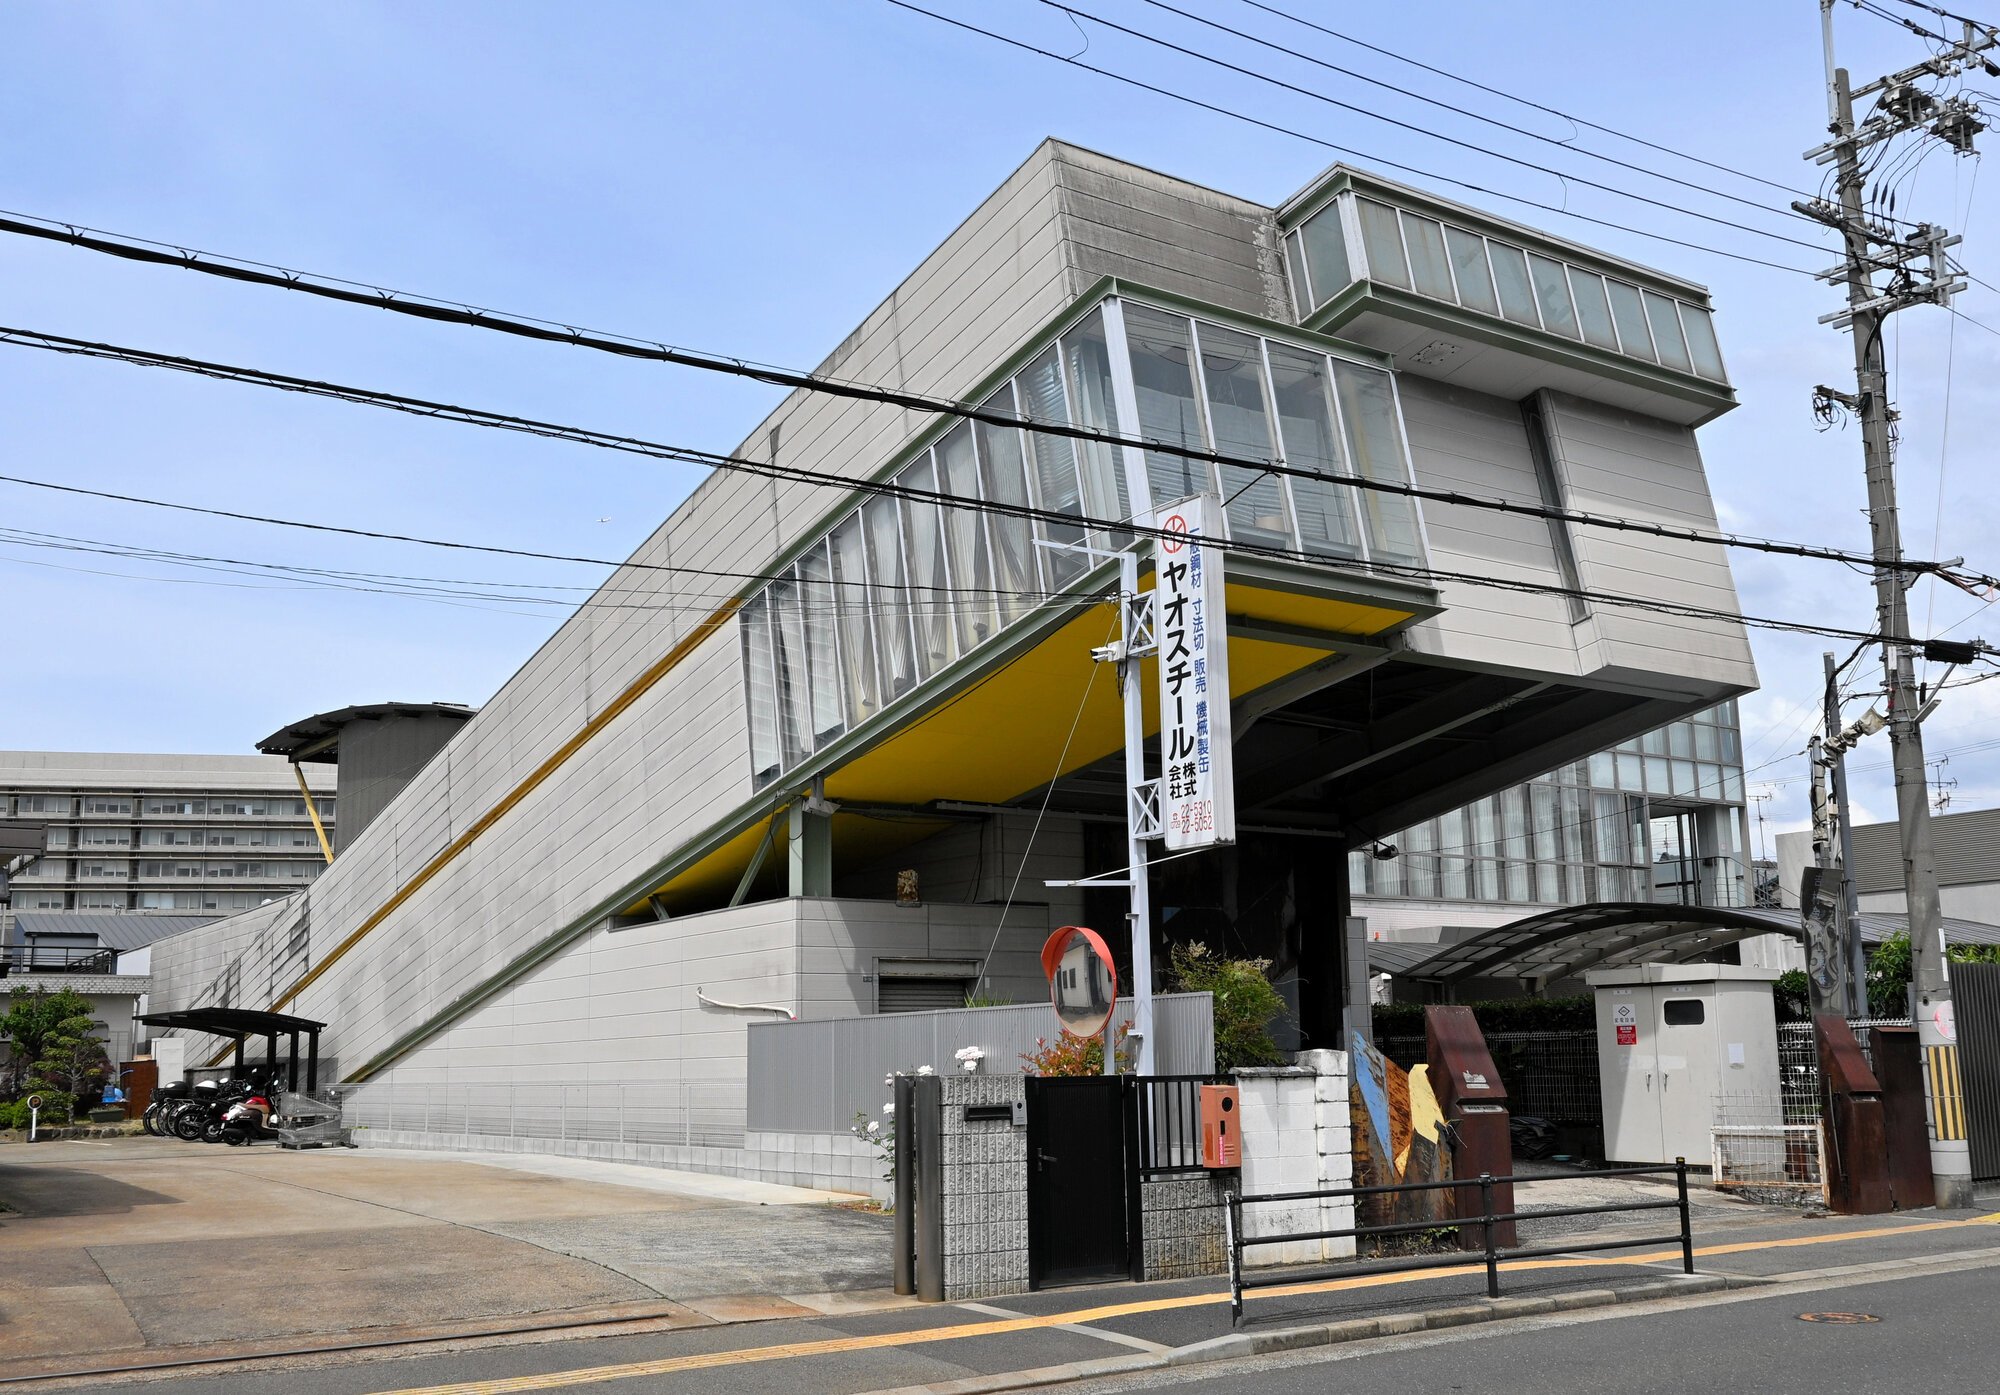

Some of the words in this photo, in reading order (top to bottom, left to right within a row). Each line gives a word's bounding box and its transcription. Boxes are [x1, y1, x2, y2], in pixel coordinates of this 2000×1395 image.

[1192, 598, 1204, 651] 寸法切
[1162, 561, 1195, 762] ヤオスチール
[1194, 659, 1207, 695] 販売
[1195, 700, 1210, 774] 機械製缶
[1168, 765, 1183, 801] 会社
[1182, 762, 1197, 797] 株式
[1180, 799, 1212, 820] 22-5310
[1181, 815, 1213, 834] 22-5052
